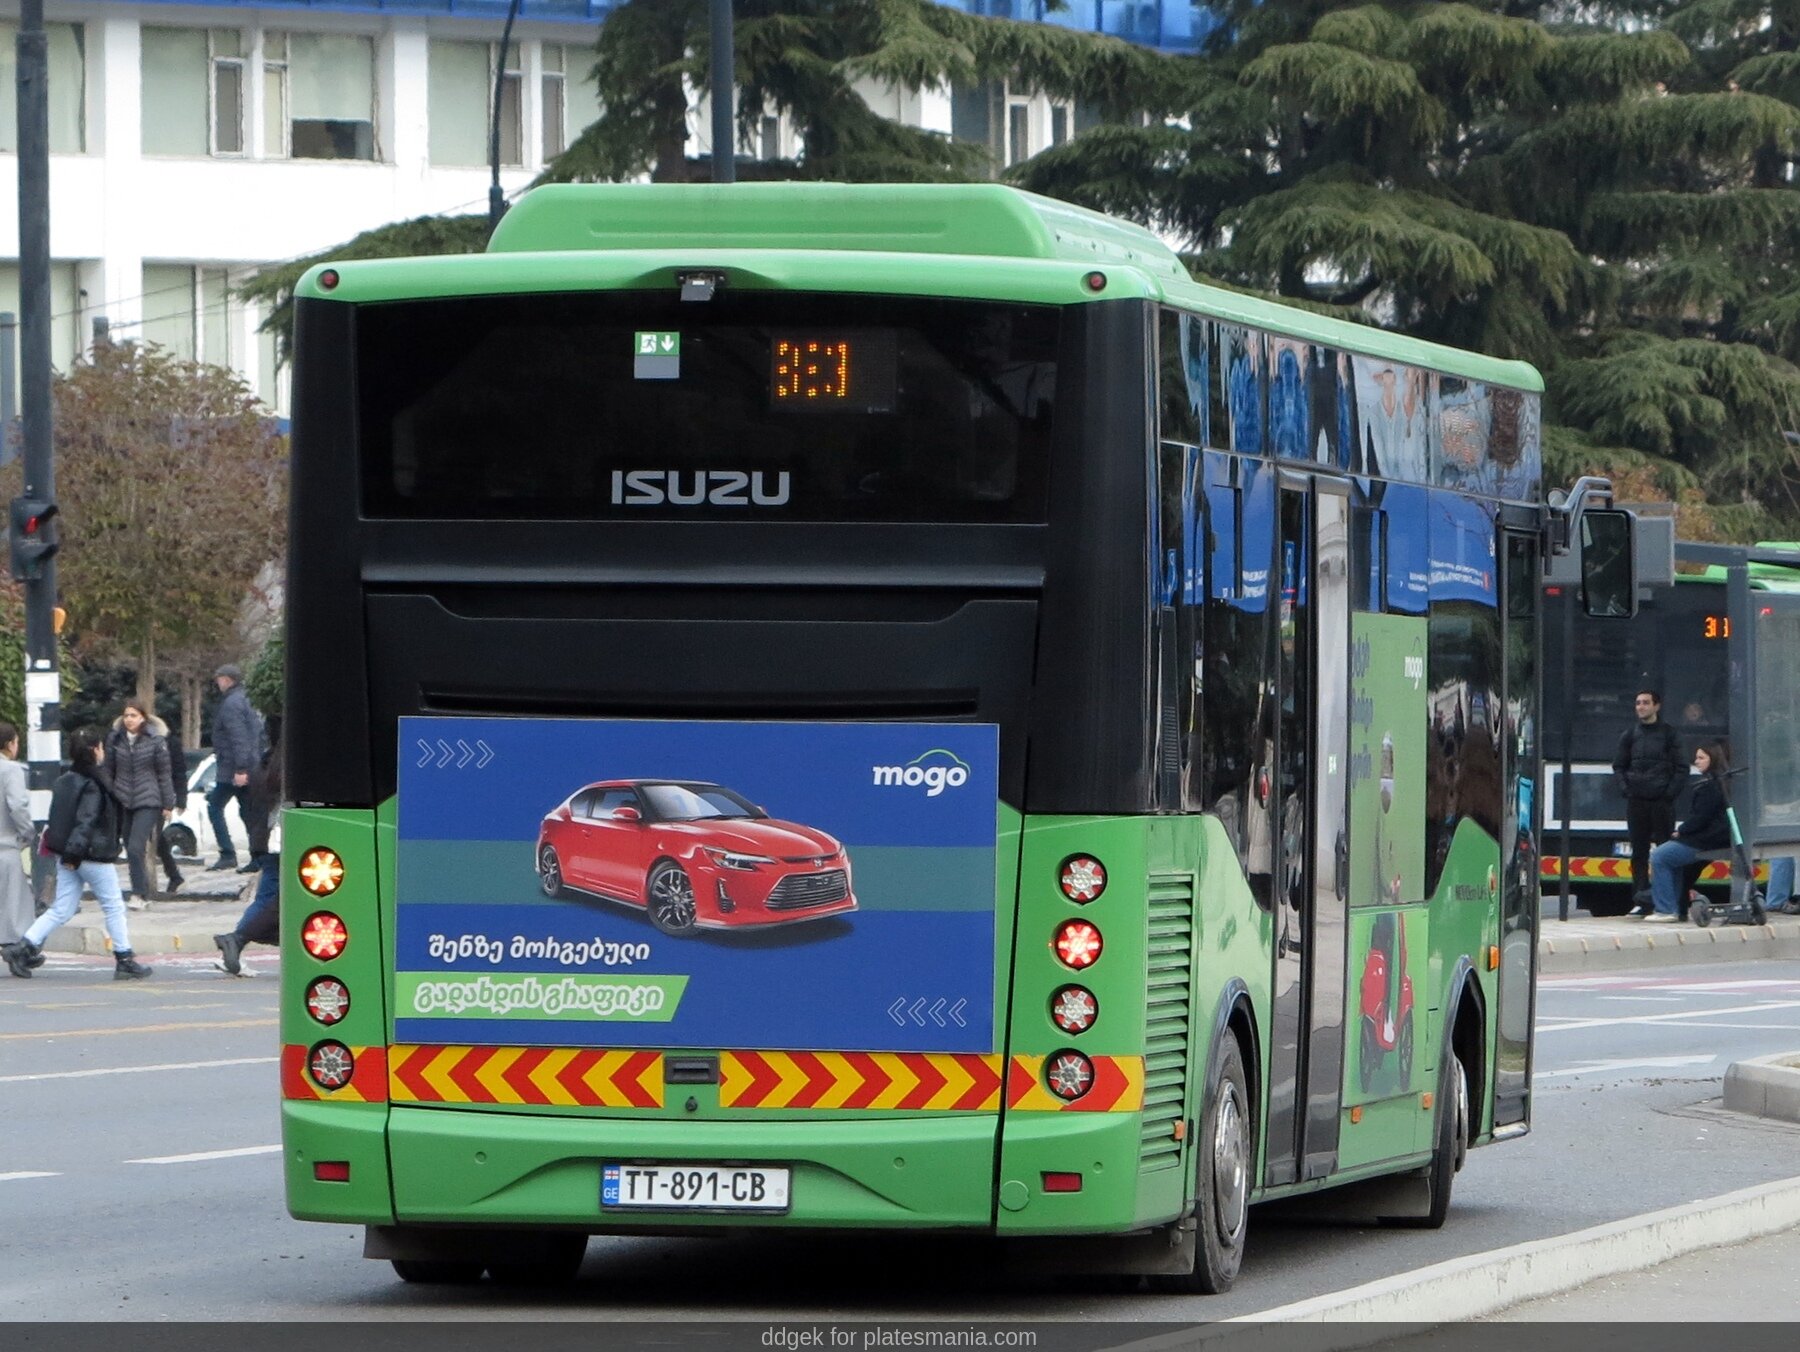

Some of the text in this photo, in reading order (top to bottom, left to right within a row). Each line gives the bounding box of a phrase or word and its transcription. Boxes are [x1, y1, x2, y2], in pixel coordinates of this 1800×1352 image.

[611, 470, 790, 505] ISUZU
[872, 765, 968, 797] mogo
[428, 934, 650, 966] შენზე მორგებული
[414, 976, 665, 1016] გადახდის გრაფიკი
[603, 1187, 618, 1199] GE
[625, 1170, 766, 1202] TT-891-CB
